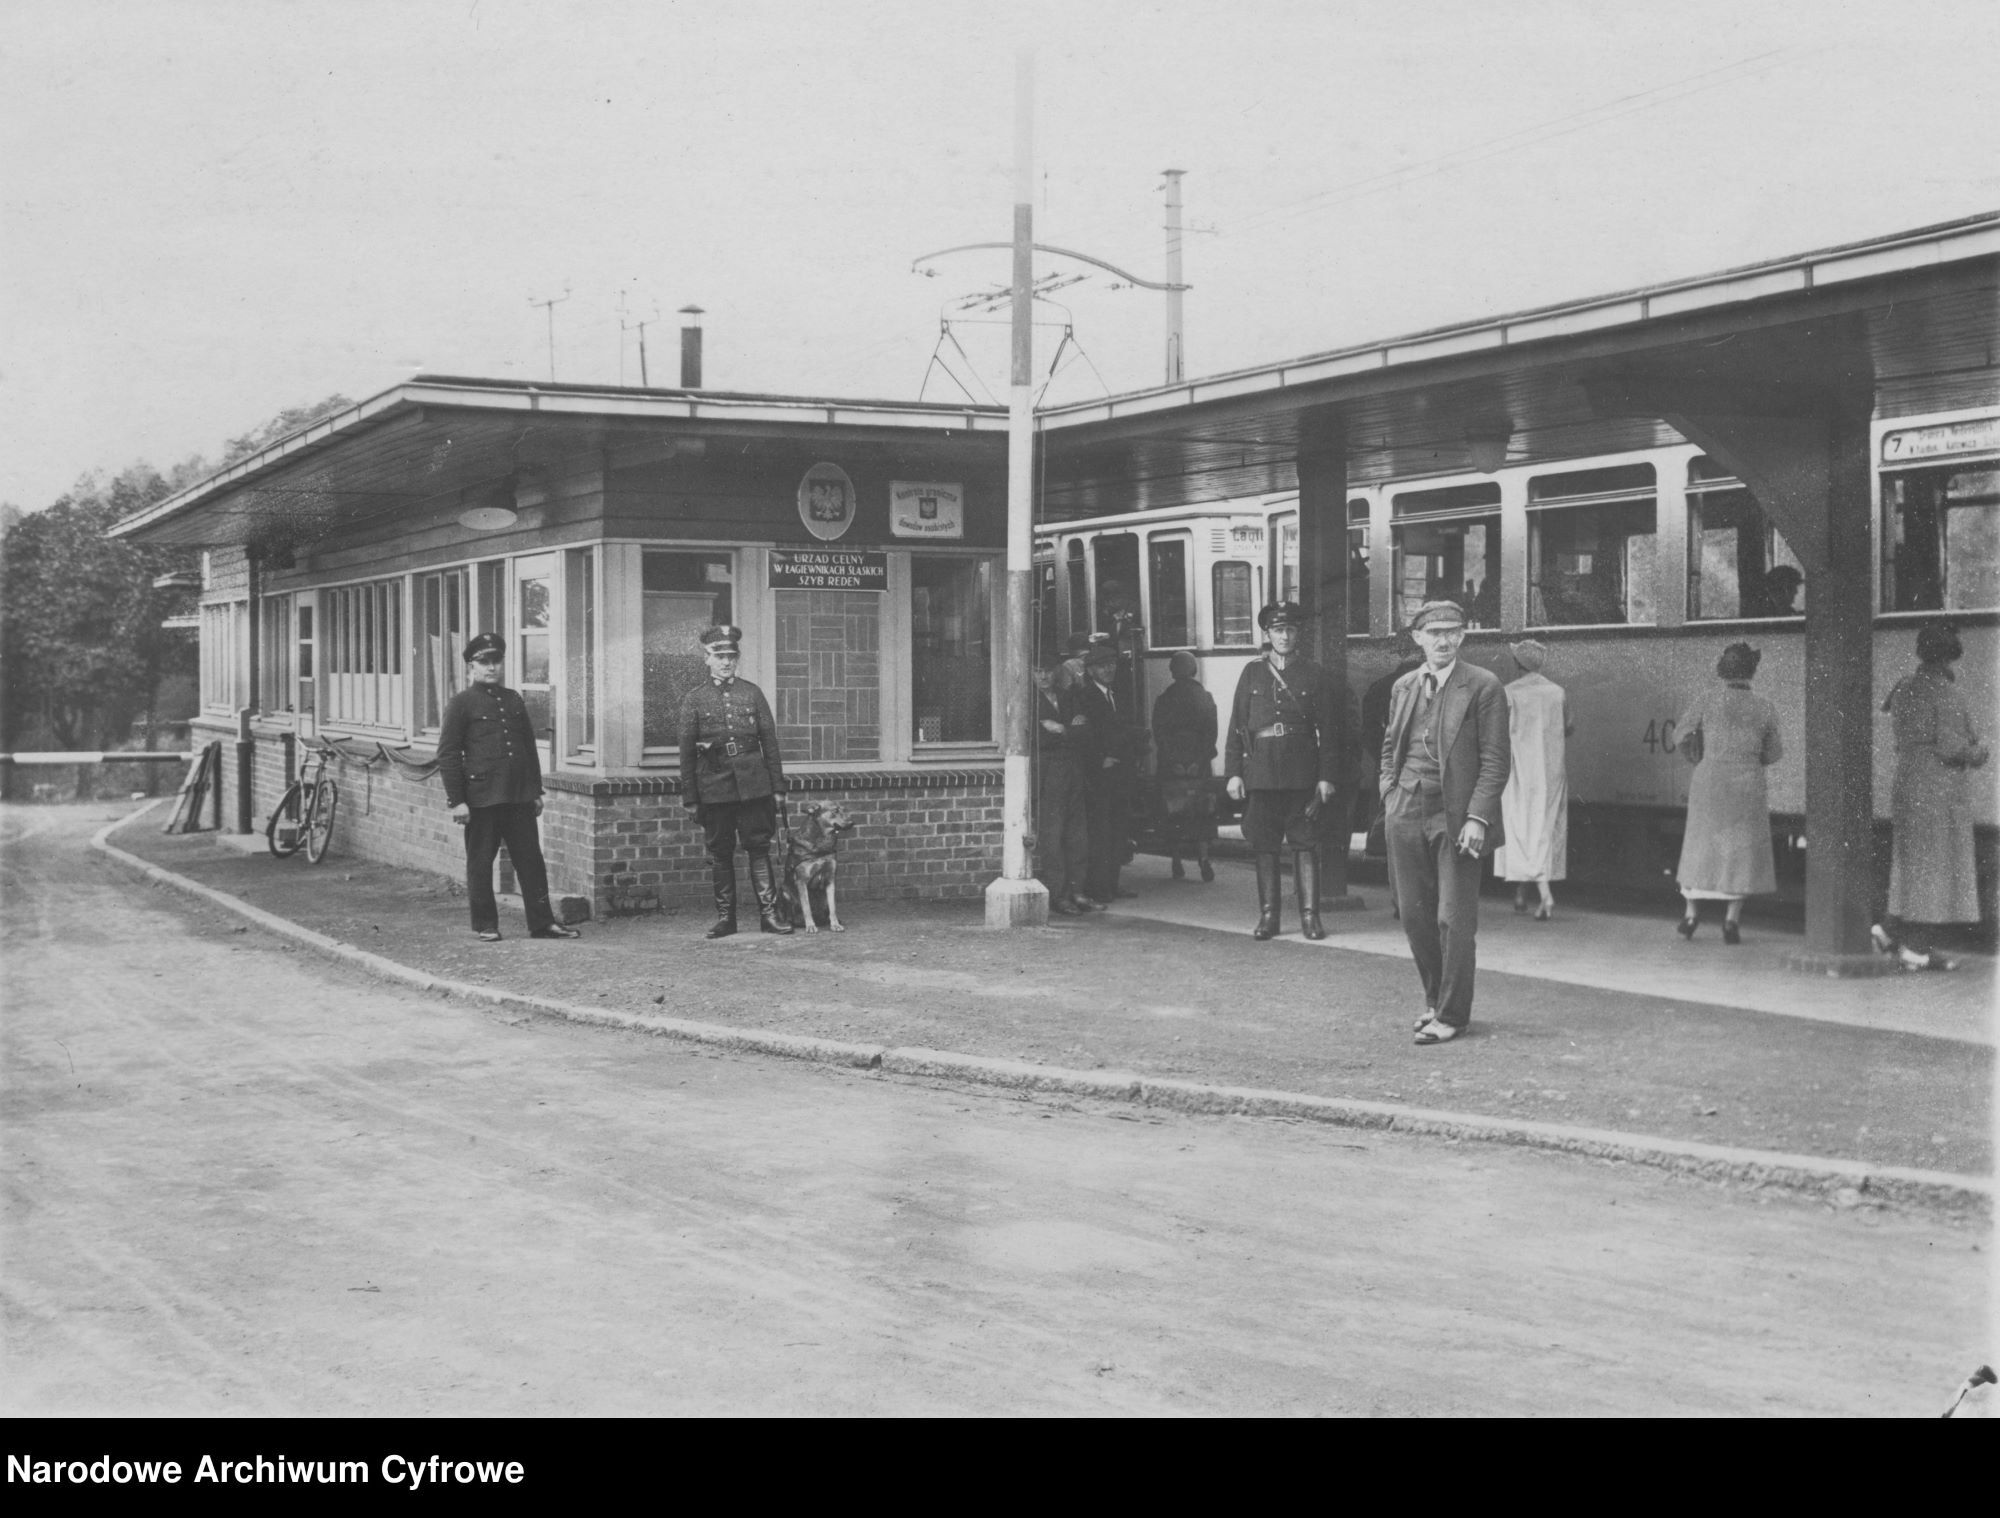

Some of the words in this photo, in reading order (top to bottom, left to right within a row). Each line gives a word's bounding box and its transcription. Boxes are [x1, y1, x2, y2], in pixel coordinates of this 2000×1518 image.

[1892, 437, 1902, 453] 7
[832, 554, 864, 565] CELNY
[773, 563, 783, 574] W
[799, 575, 825, 586] SZYB
[828, 576, 860, 587] REDEN
